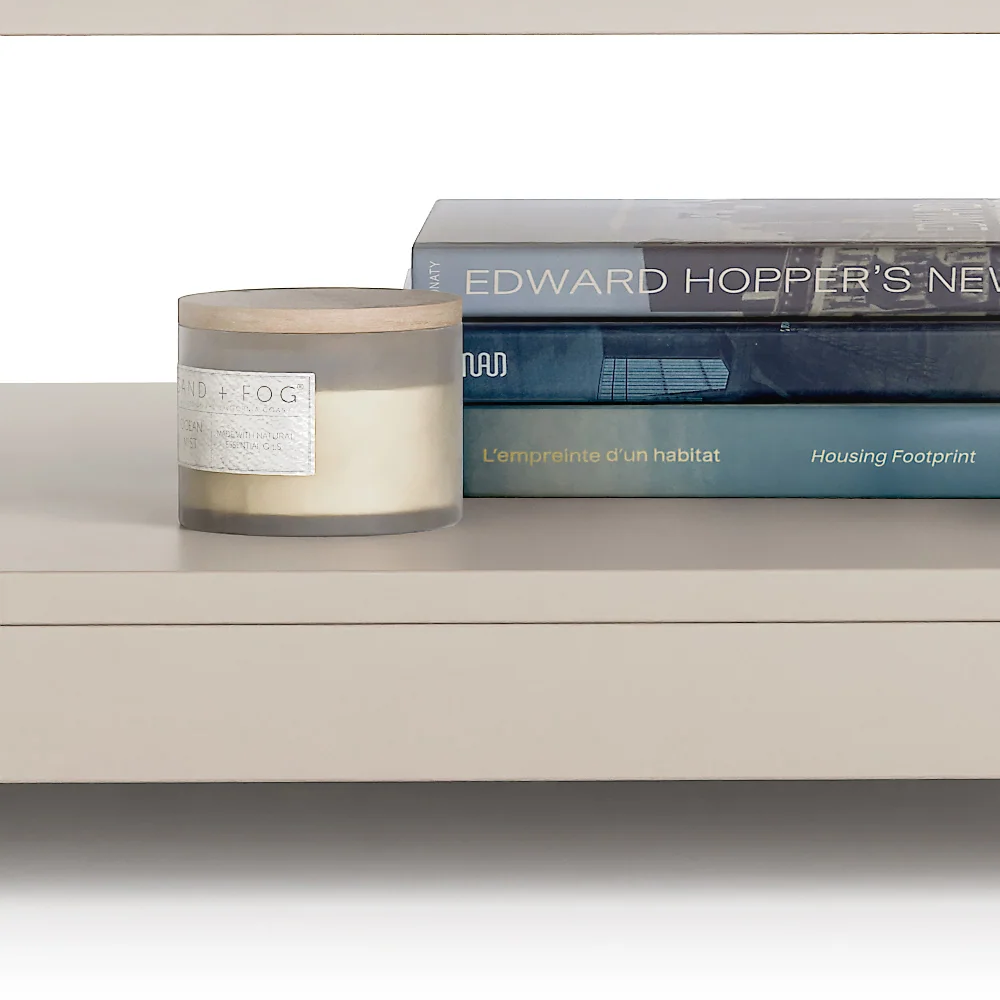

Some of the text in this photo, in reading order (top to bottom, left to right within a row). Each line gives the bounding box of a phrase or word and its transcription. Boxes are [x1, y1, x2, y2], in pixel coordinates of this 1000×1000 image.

[429, 260, 440, 292] NATY
[465, 269, 668, 295] EDWARD
[685, 267, 911, 294] HOPPER'S
[178, 379, 207, 399] AND
[483, 448, 721, 466] L'empreinte d'un habitat
[811, 449, 977, 467] Housing Footprint
